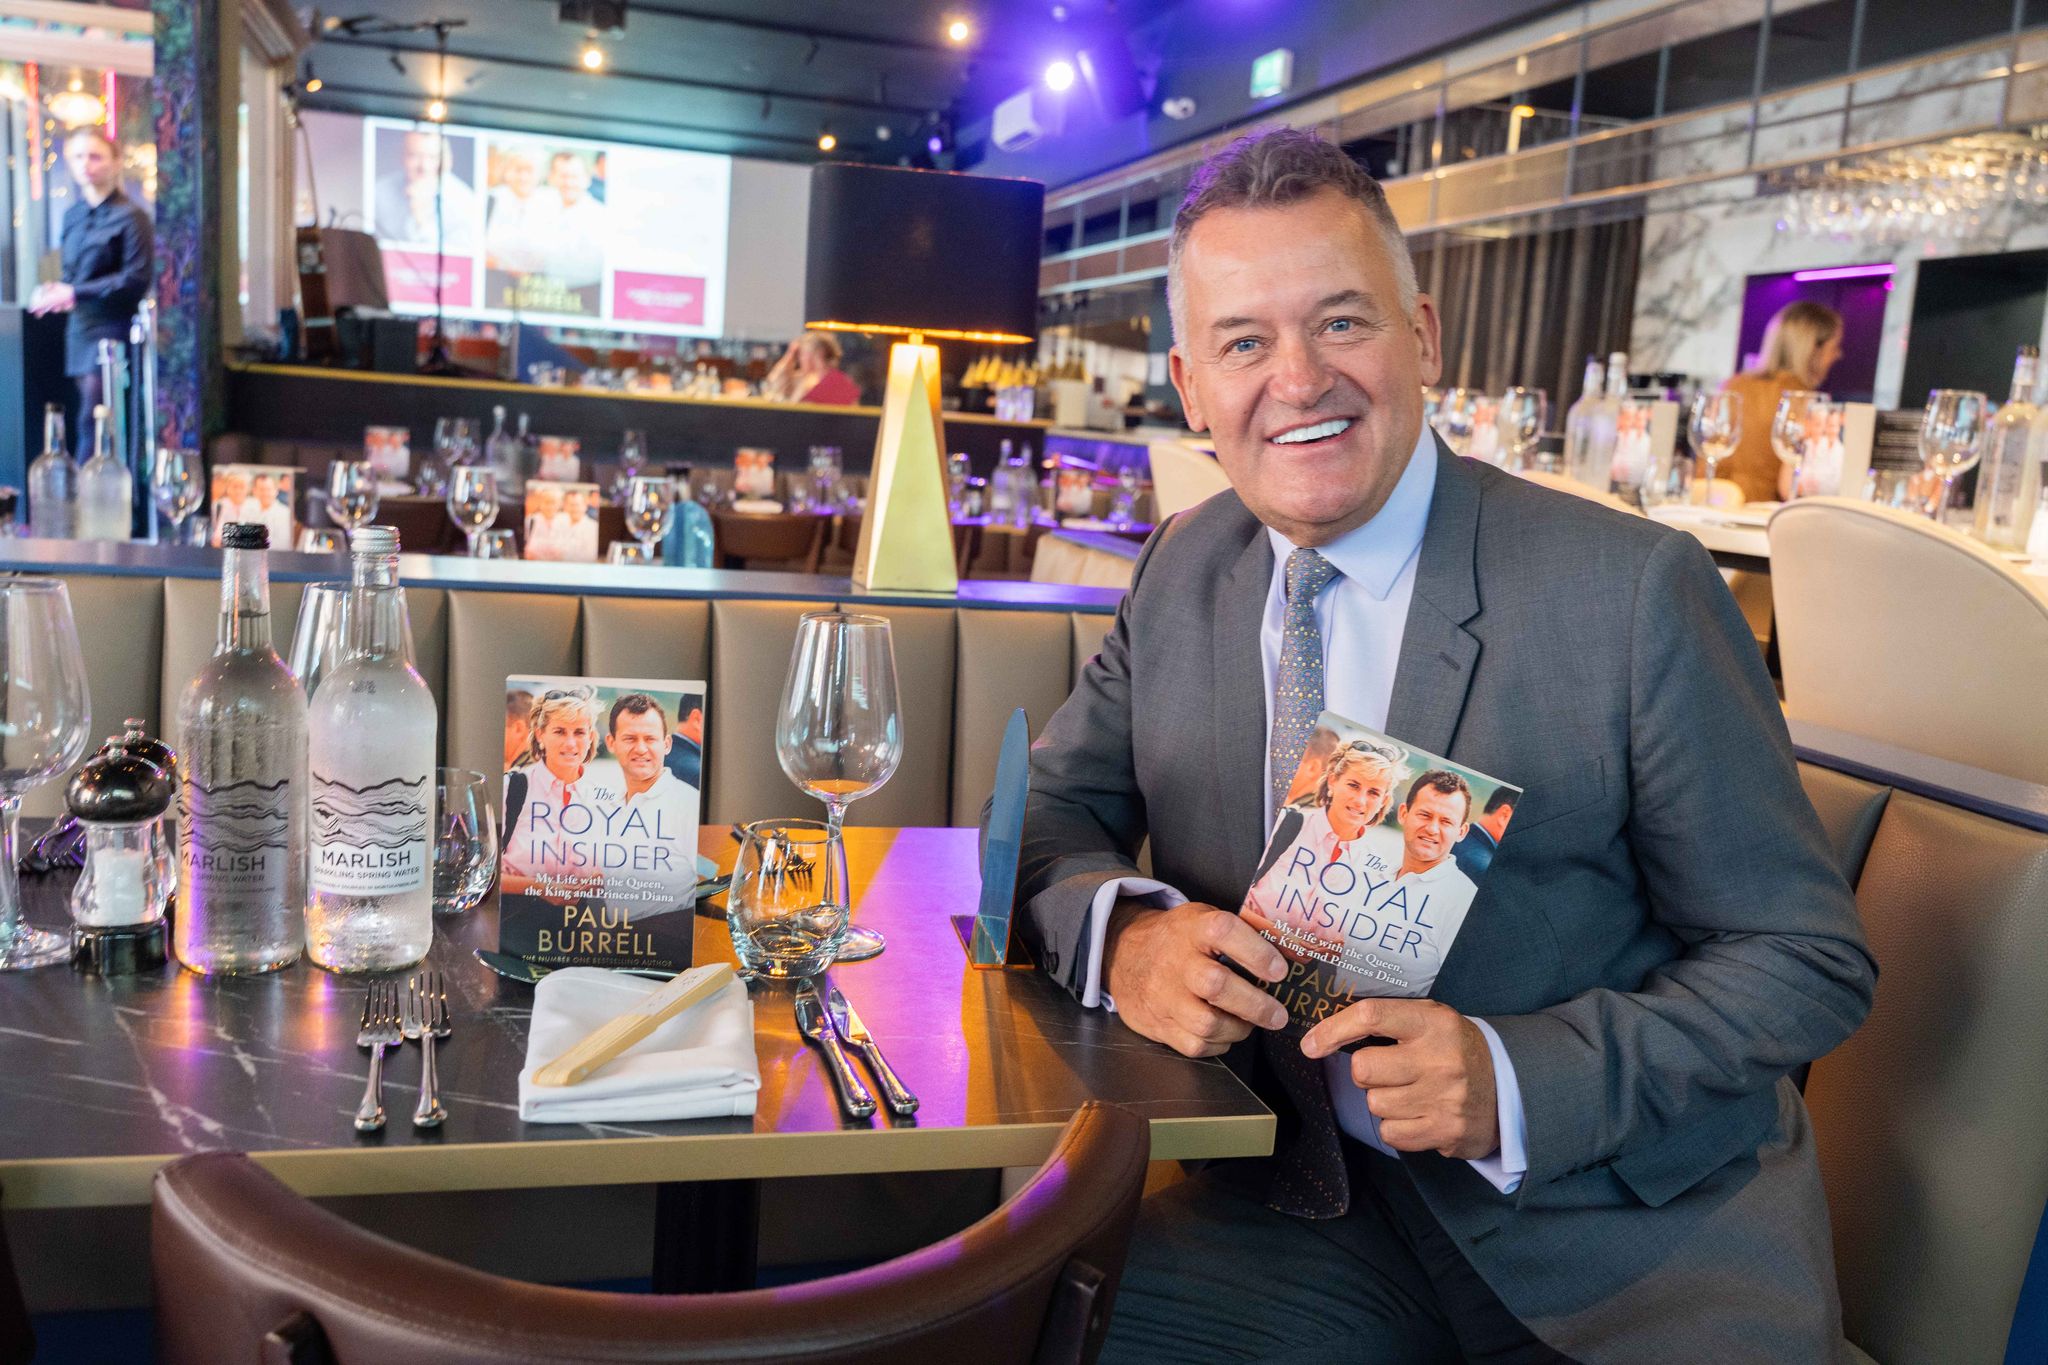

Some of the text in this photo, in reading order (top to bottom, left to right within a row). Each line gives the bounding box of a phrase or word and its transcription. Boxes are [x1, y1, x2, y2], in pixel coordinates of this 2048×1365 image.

[593, 786, 616, 801] The
[530, 802, 676, 841] ROYAL
[181, 851, 265, 871] MARLISH
[322, 850, 411, 868] MARLISH
[530, 839, 673, 872] INSIDER
[1365, 853, 1388, 873] The
[232, 873, 265, 882] WATER
[314, 865, 420, 879] SPARKLING SPRING WATER
[535, 873, 665, 890] My Life with the Queen,
[525, 887, 675, 902] the King and Princess Diana
[1286, 846, 1434, 931] ROYAL
[563, 905, 634, 930] PAUL
[1276, 884, 1423, 958] INSIDER
[538, 929, 657, 956] BURRELL
[1273, 920, 1404, 974] My Life with the Queen,
[538, 955, 570, 963] NUMBER
[592, 957, 639, 966] BESTSELLING
[641, 959, 672, 967] AUTHOR
[1259, 929, 1409, 988] the King and Princess Diana
[1287, 962, 1358, 1004] PAUL
